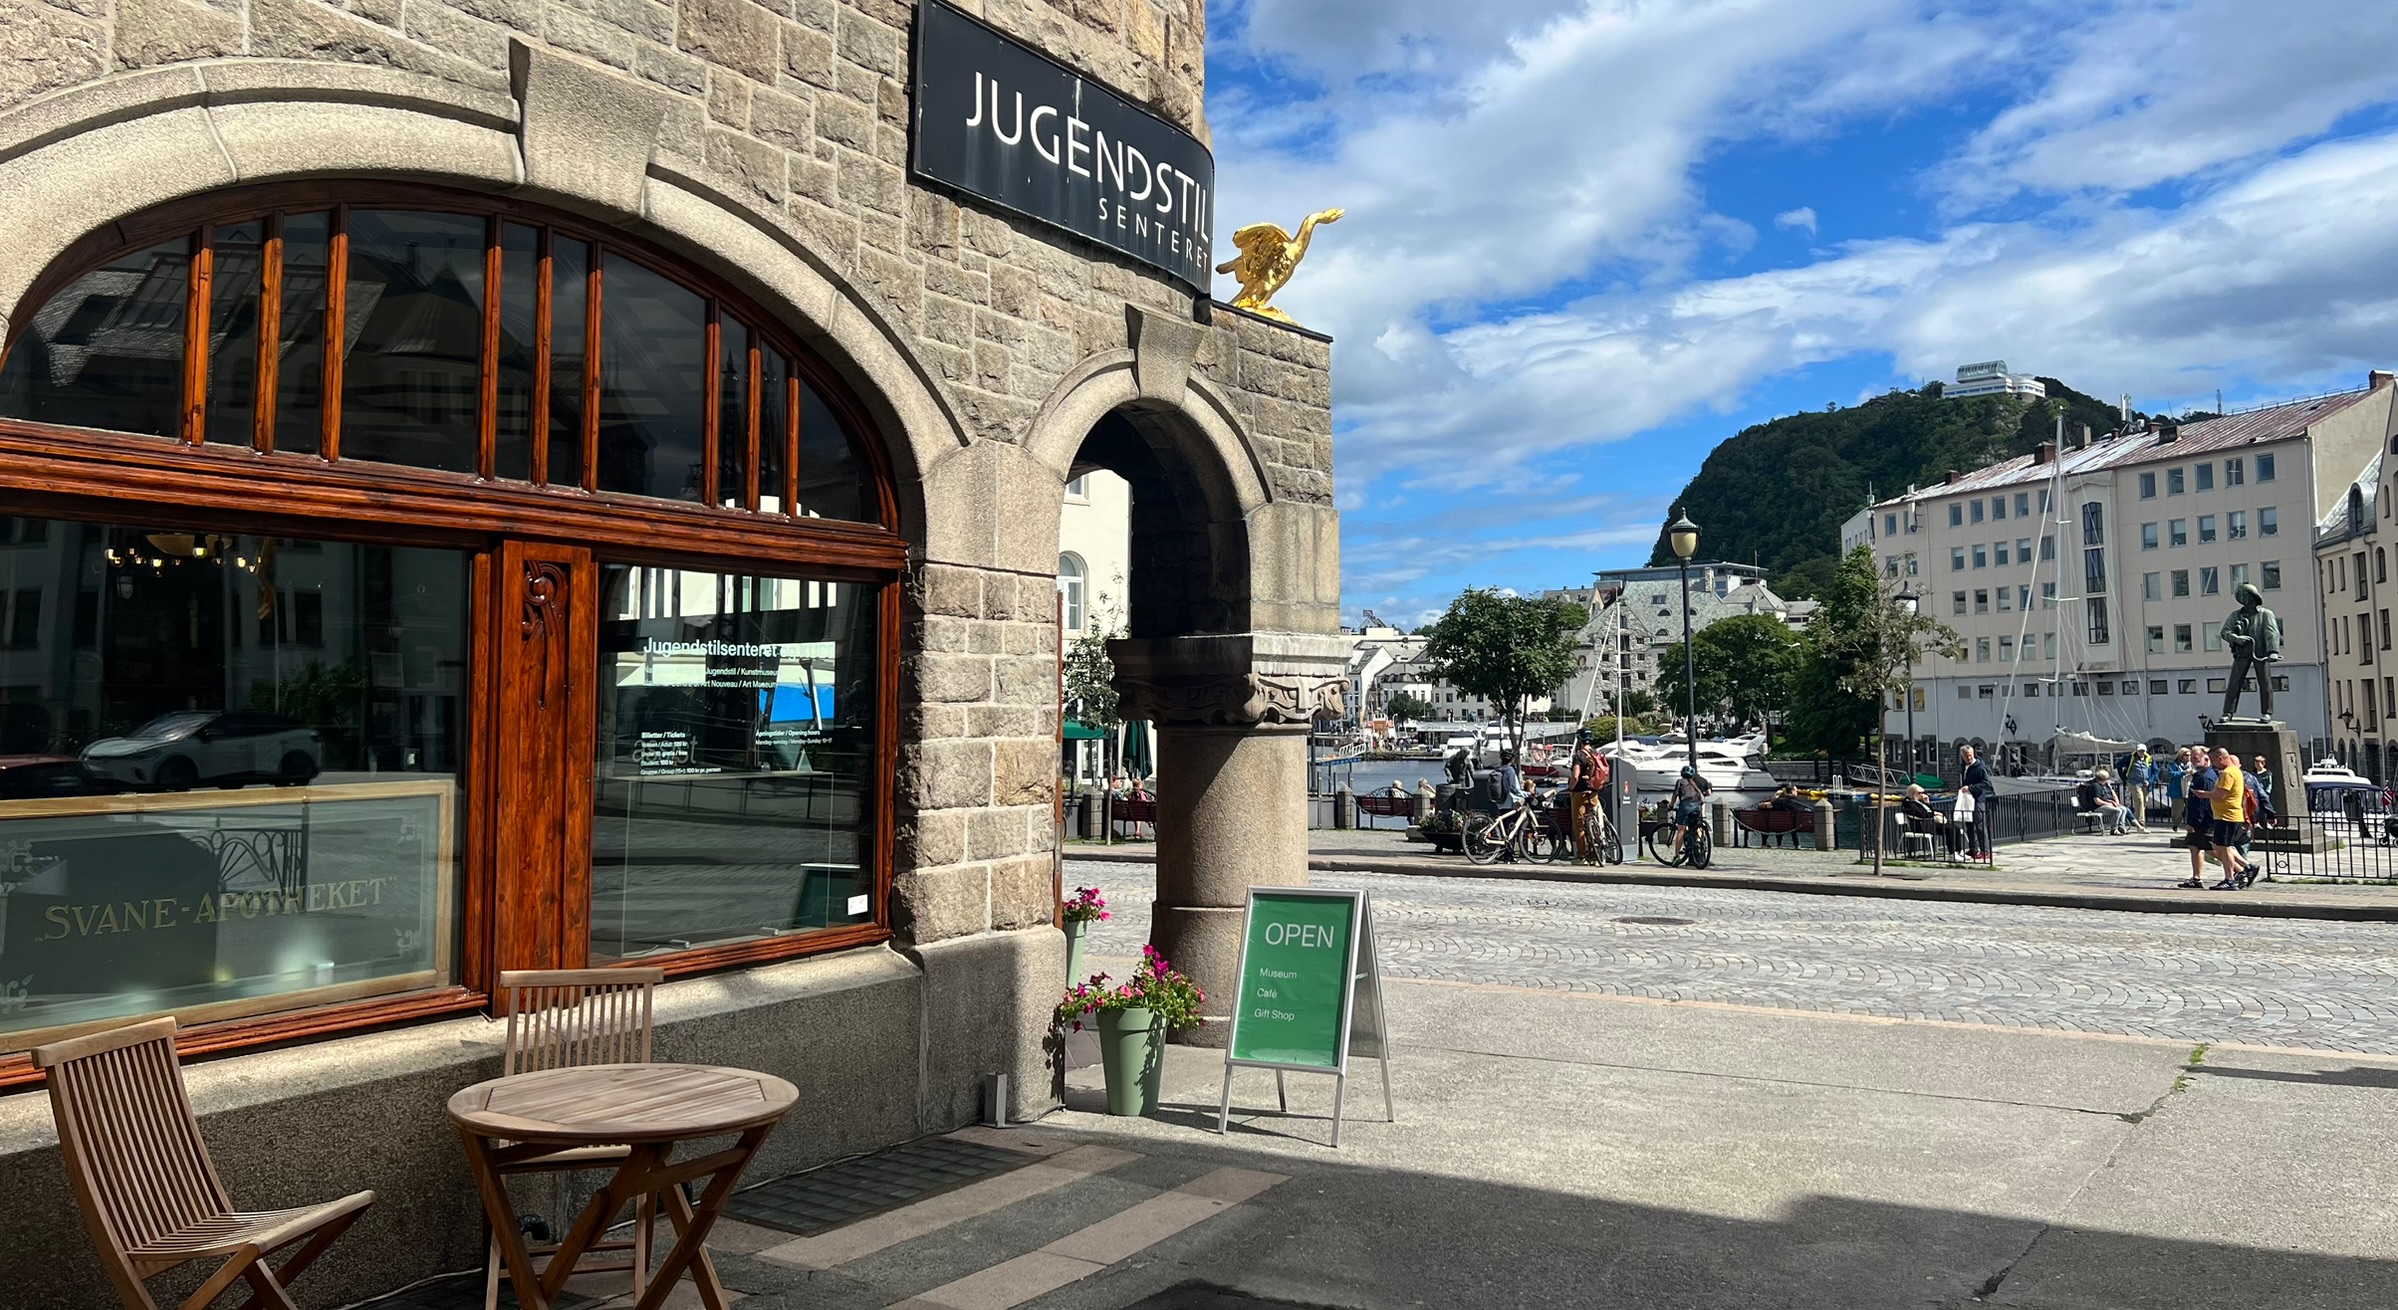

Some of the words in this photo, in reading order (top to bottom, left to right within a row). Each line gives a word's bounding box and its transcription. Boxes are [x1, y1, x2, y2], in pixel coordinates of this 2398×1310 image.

[966, 71, 1209, 243] JUGENDSTIL
[1099, 197, 1208, 274] SENTERET
[643, 637, 777, 657] Jugendstilsenteret
[1265, 923, 1334, 948] OPEN
[1259, 968, 1297, 979] Museum
[1256, 988, 1278, 998] Café
[1254, 1008, 1270, 1018] Gift
[1272, 1010, 1294, 1021] Shop
